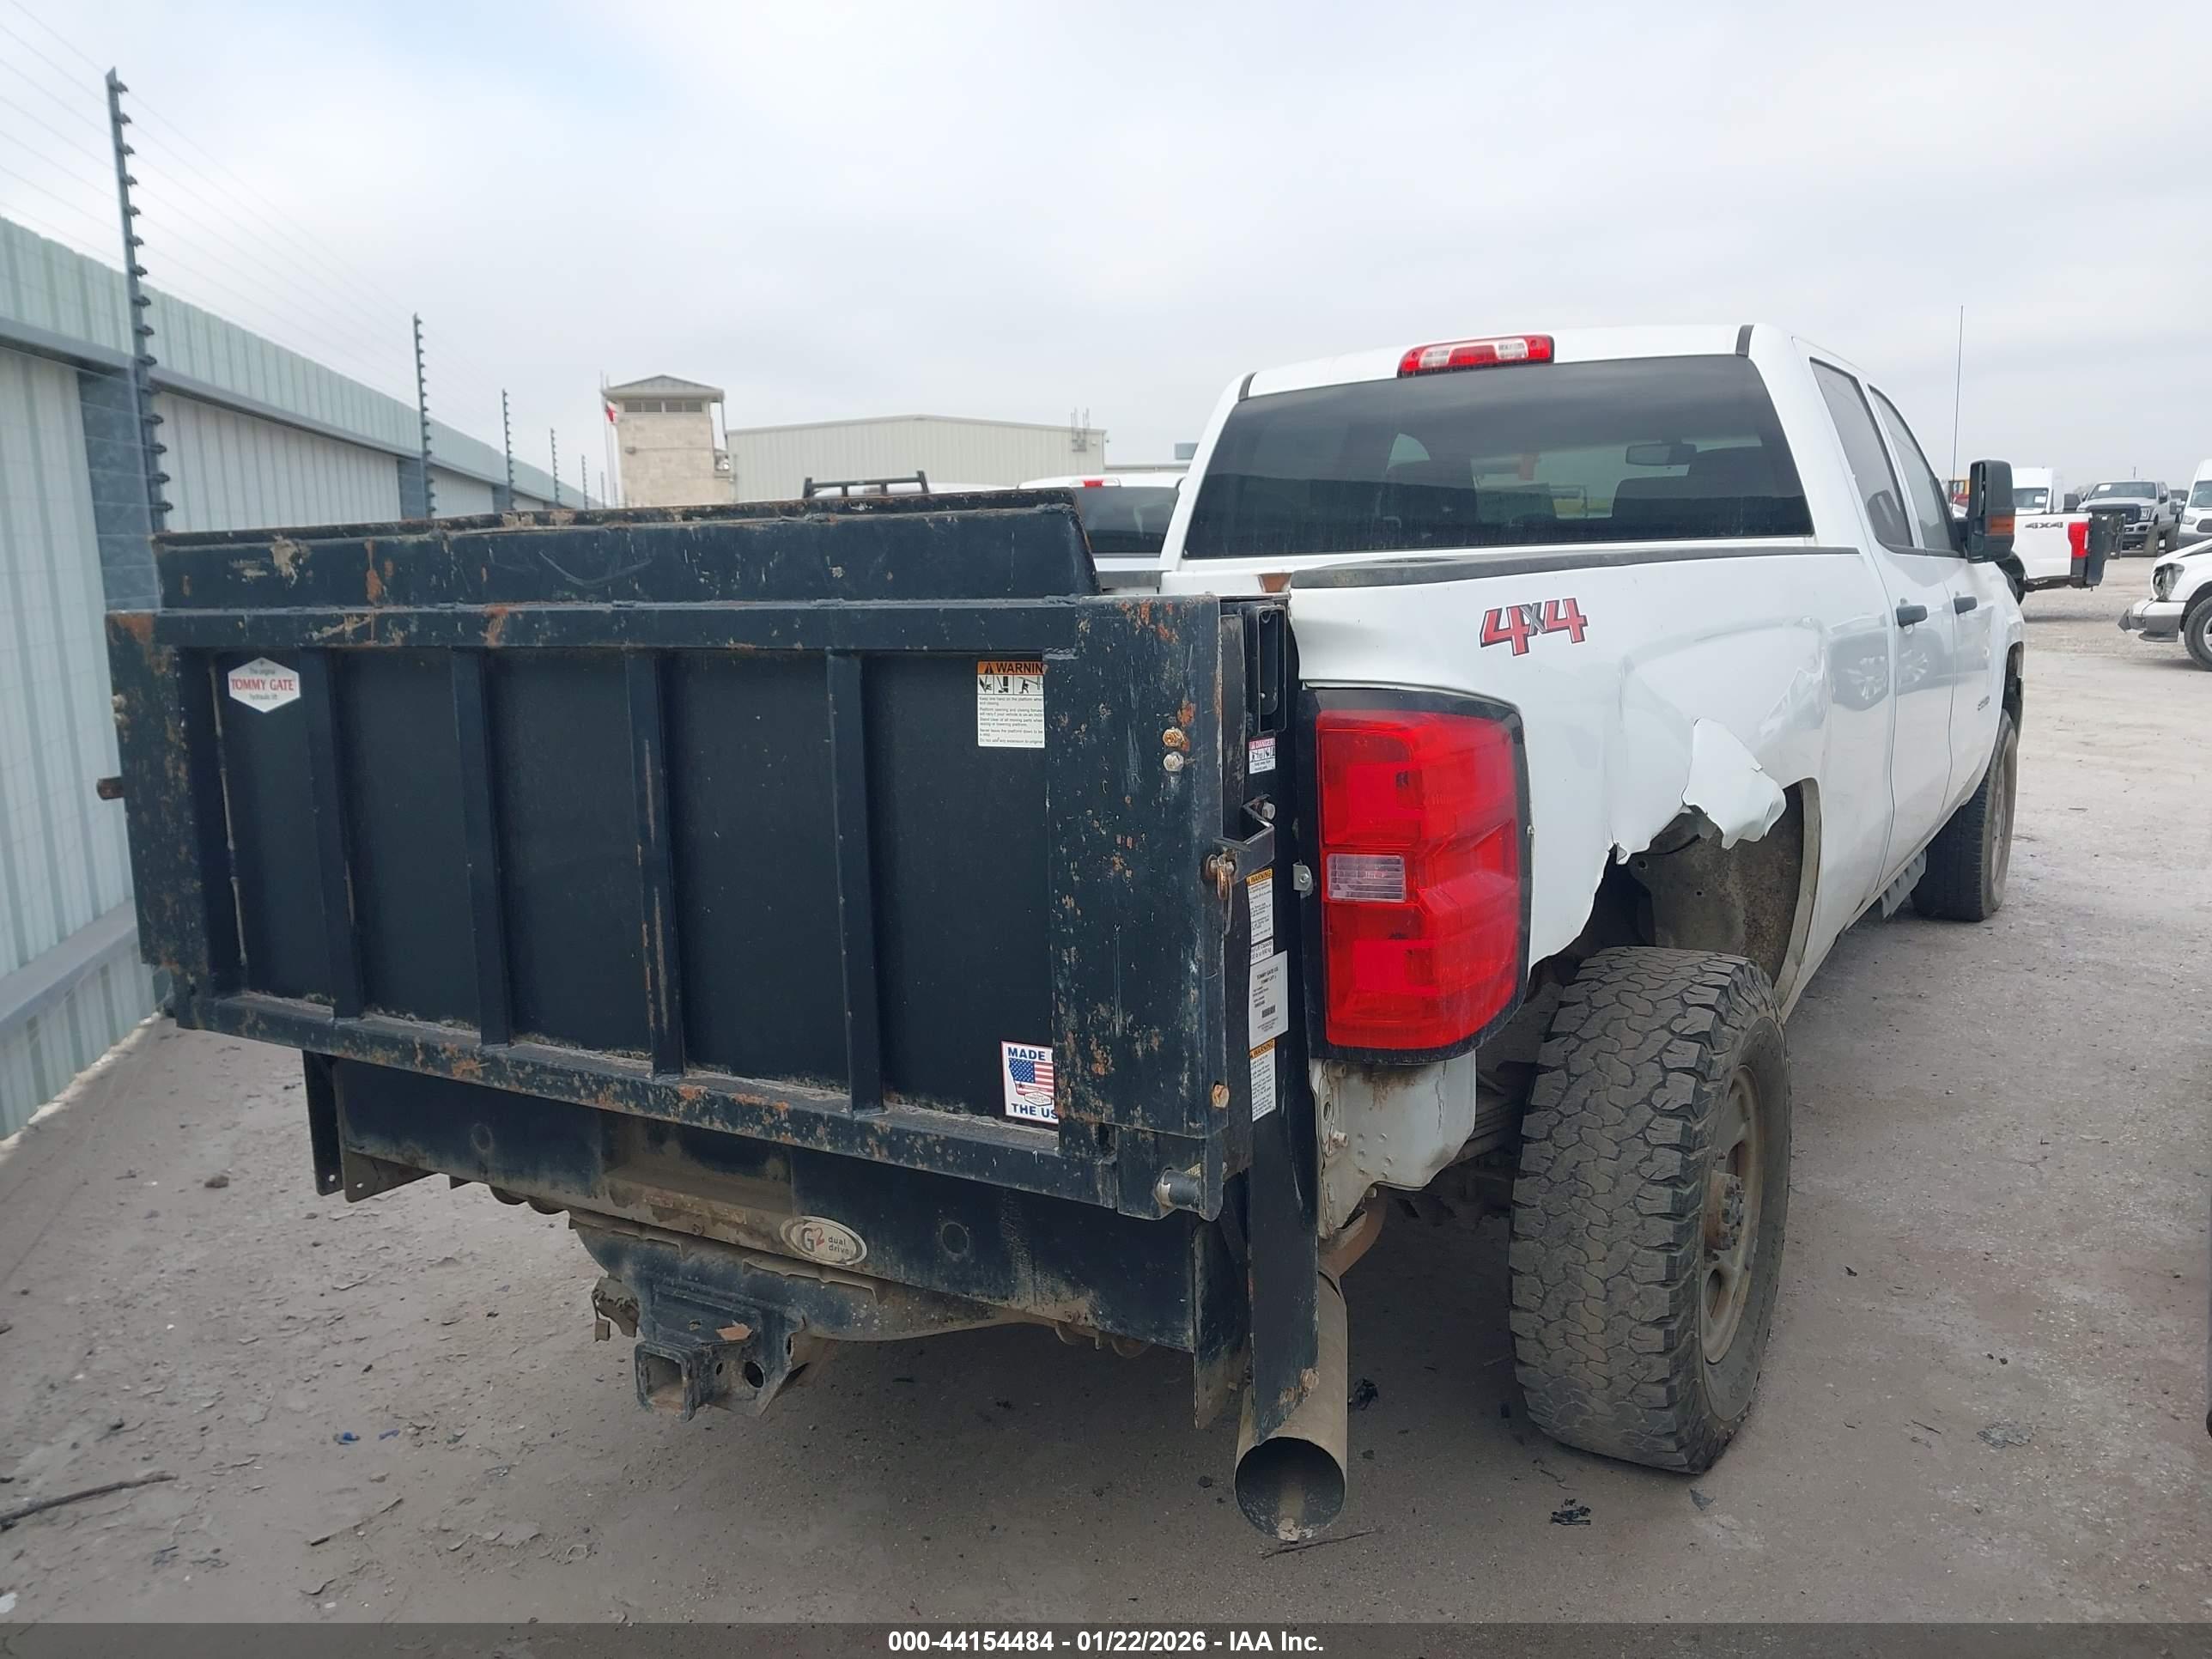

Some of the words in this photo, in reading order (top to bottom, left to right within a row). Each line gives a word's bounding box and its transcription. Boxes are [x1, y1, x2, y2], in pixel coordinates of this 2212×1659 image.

[996, 663, 1043, 674] WARNIN
[231, 678, 266, 691] TOMMY
[270, 678, 295, 691] GATE
[1007, 1047, 1046, 1061] MADE
[1011, 1103, 1037, 1115] THE
[1041, 1107, 1059, 1120] US
[829, 1236, 846, 1245] dual
[829, 1244, 850, 1255] drive
